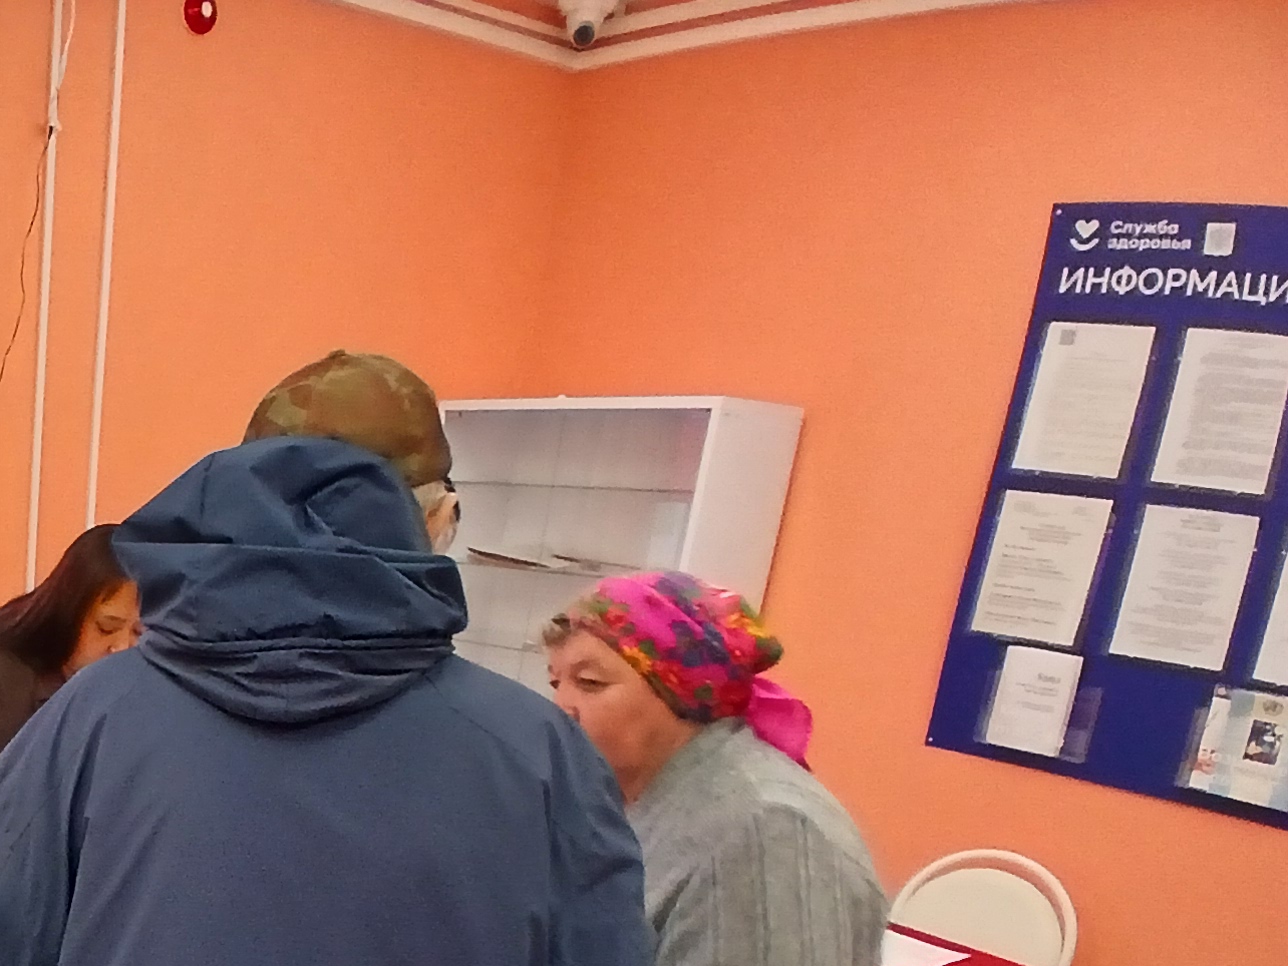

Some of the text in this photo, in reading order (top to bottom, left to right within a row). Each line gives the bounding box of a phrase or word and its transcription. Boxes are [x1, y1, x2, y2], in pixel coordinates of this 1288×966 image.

[1109, 219, 1180, 236] Служба
[1107, 238, 1192, 251] здоровья
[1058, 265, 1288, 305] ИНФОРМАЦИ
